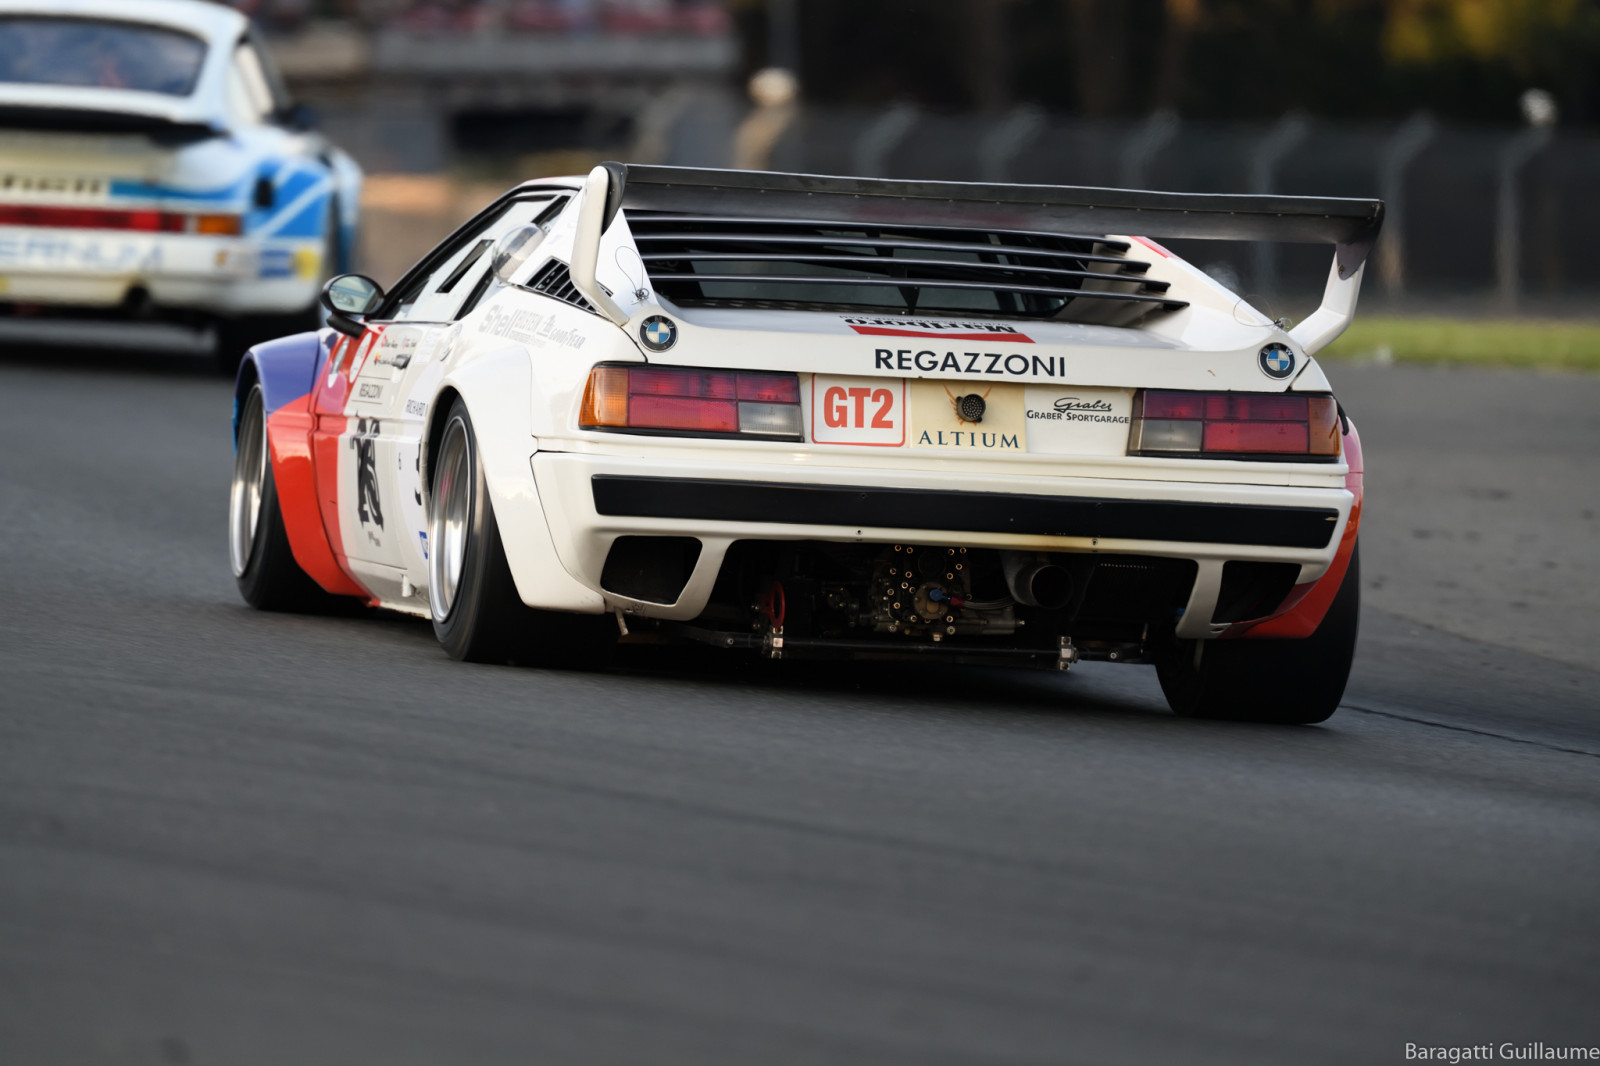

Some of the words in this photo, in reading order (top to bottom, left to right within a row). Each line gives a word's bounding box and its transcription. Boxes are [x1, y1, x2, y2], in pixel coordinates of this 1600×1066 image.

[479, 304, 519, 337] Shell
[844, 318, 1019, 334] Marlboro
[875, 348, 1065, 377] REGAZZONI
[823, 386, 894, 429] GT2
[1053, 397, 1112, 413] Graber
[1026, 409, 1062, 421] GRABER
[1066, 411, 1130, 424] SPORTGARAGE
[918, 429, 1020, 449] ALTIUM
